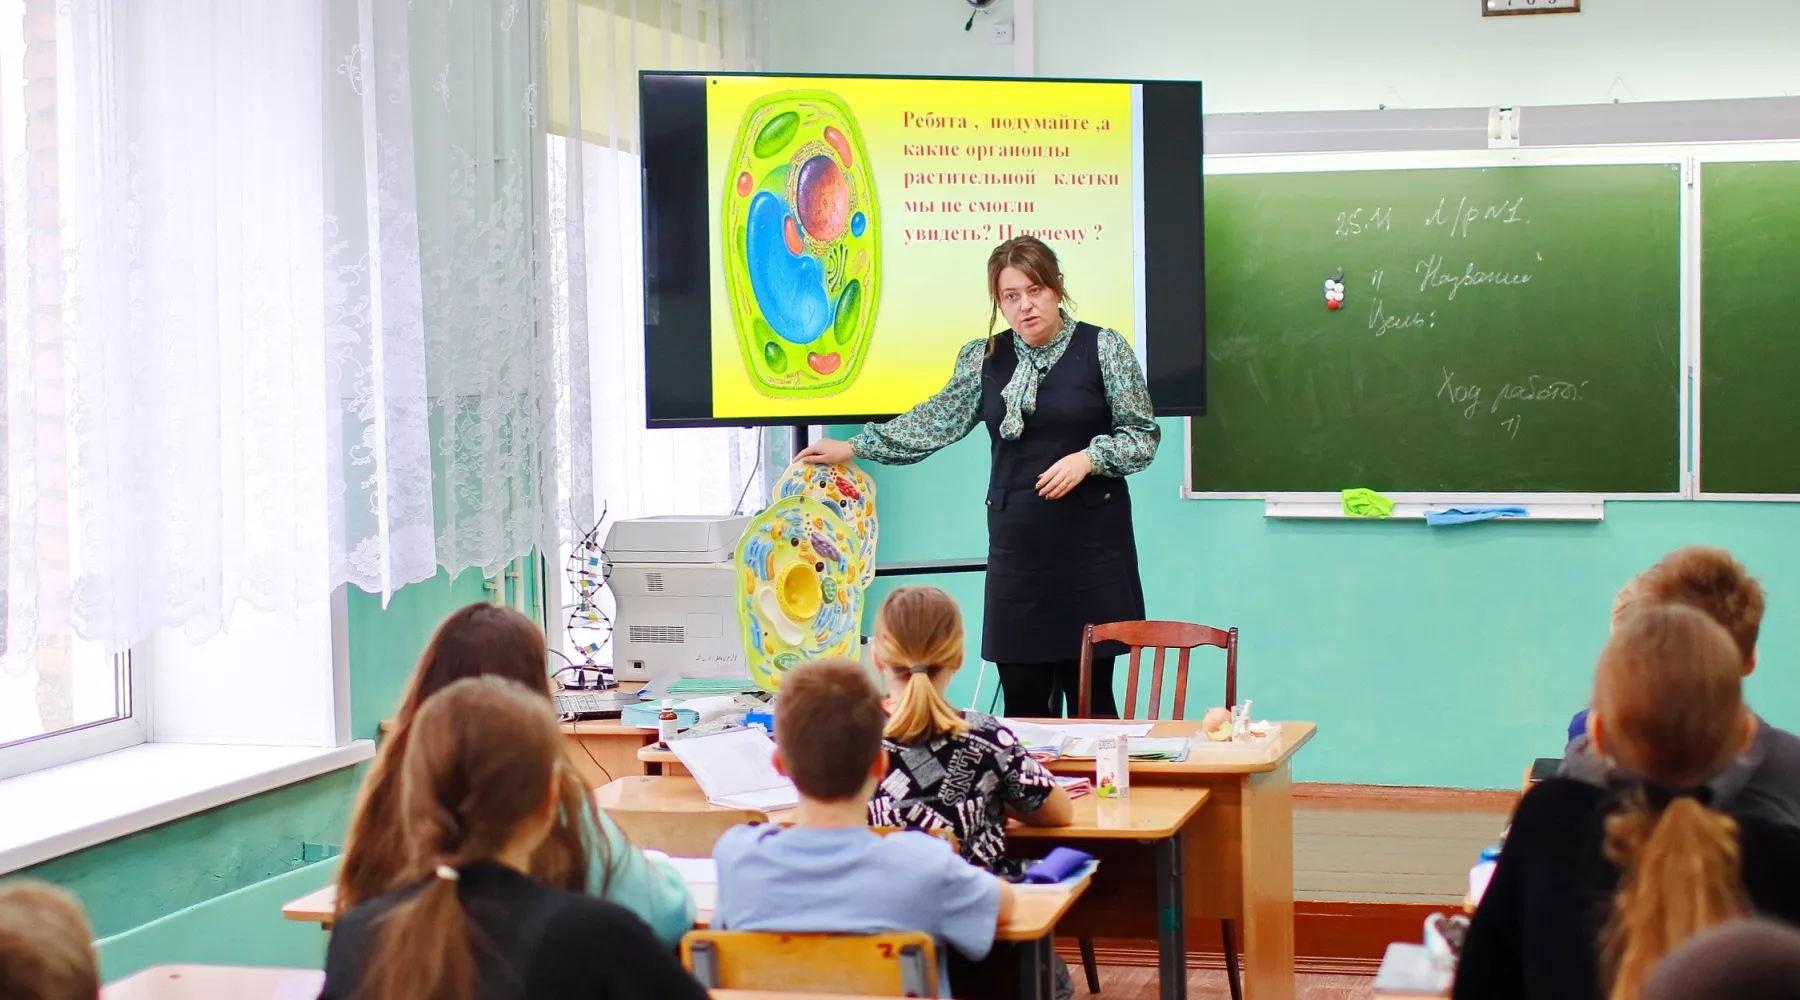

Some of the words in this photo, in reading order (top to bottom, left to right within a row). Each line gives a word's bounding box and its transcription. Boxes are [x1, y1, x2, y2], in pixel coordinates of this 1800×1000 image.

[903, 111, 967, 129] Ребята
[990, 113, 1089, 134] подумайте
[903, 144, 960, 156] какие
[966, 145, 1070, 161] органоиды
[903, 168, 1036, 189] растительной
[1054, 173, 1120, 186] клетки
[904, 201, 935, 213] мы
[941, 201, 962, 213] не
[968, 201, 1035, 213] смогли
[1335, 207, 1393, 238] 25.11
[904, 223, 992, 245] увидеть?
[999, 223, 1014, 241] И
[1020, 229, 1088, 245] почему
[1437, 365, 1484, 420] Ход
[941, 747, 984, 807] LNS
